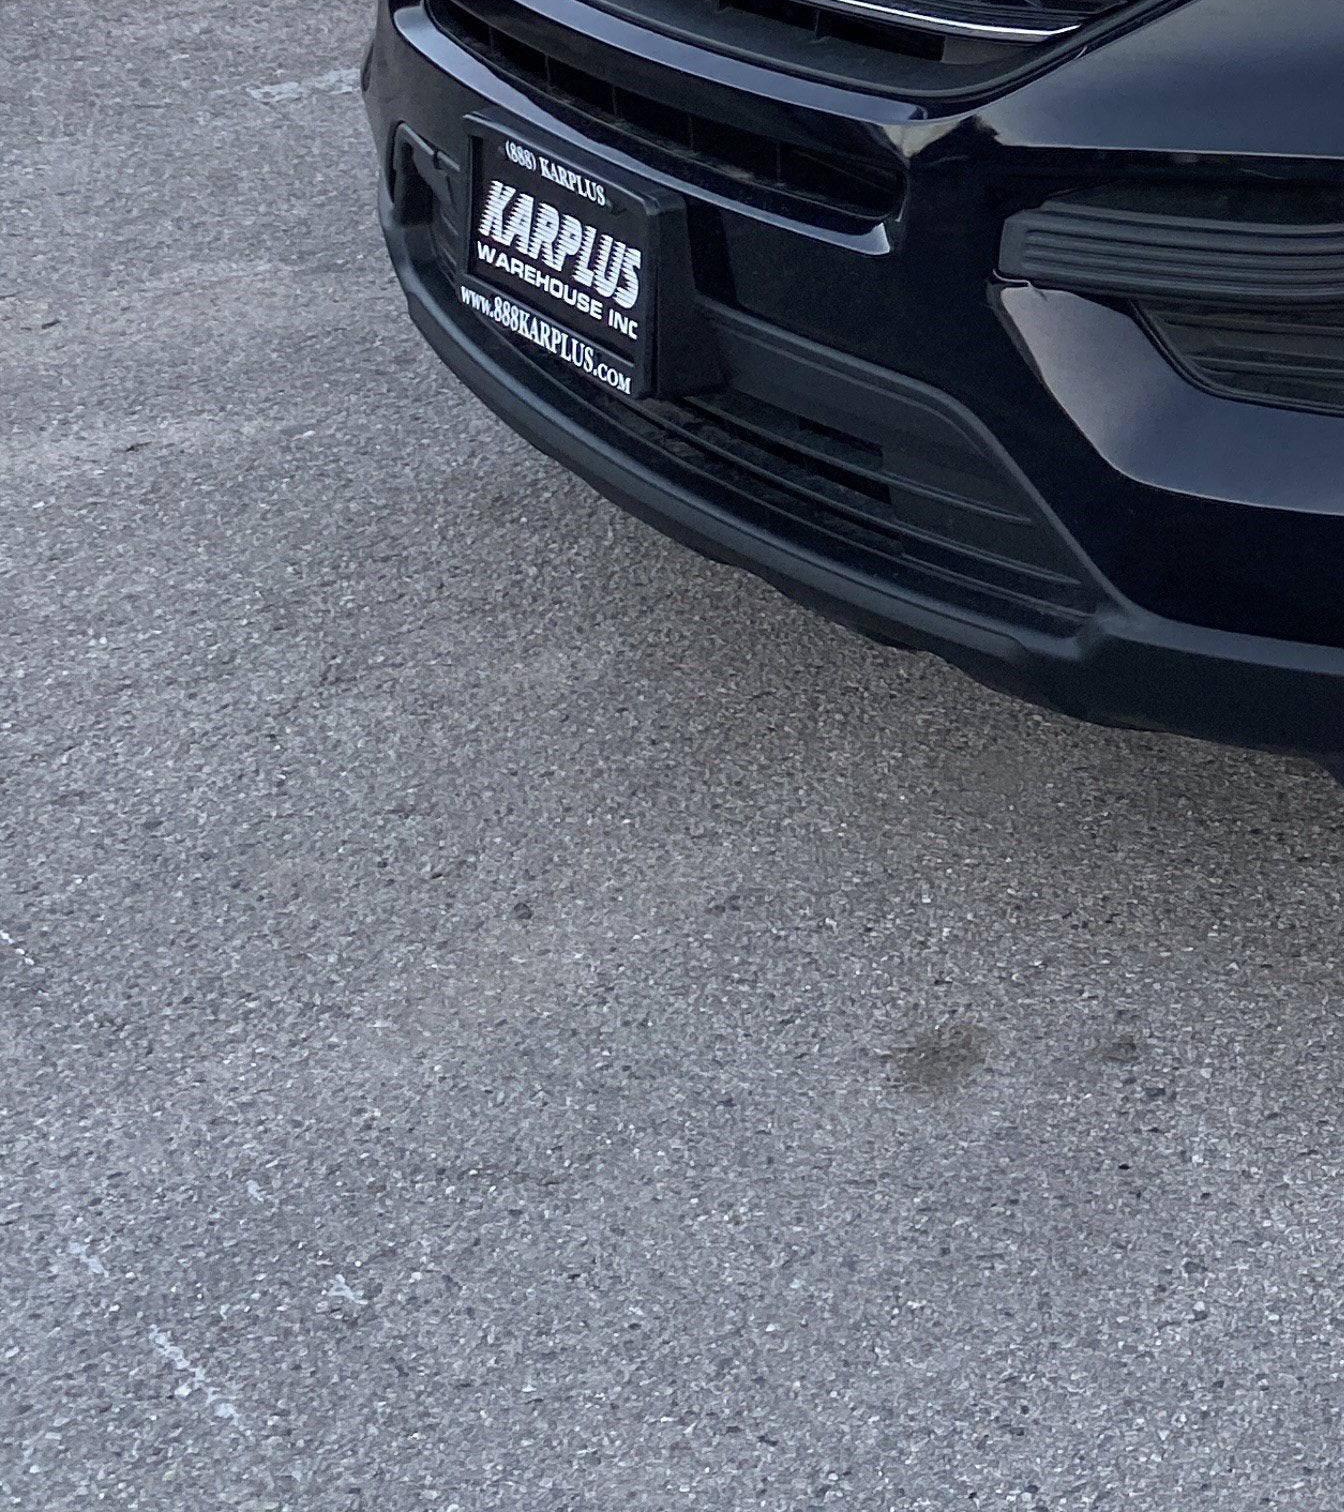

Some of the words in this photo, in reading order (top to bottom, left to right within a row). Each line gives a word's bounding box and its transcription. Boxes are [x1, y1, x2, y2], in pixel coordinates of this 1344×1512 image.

[505, 139, 537, 172] (888)
[539, 156, 606, 207] KARPLUS
[476, 240, 603, 320] WAREHOUSE
[608, 308, 638, 340] INC
[477, 180, 642, 309] KARPLUS
